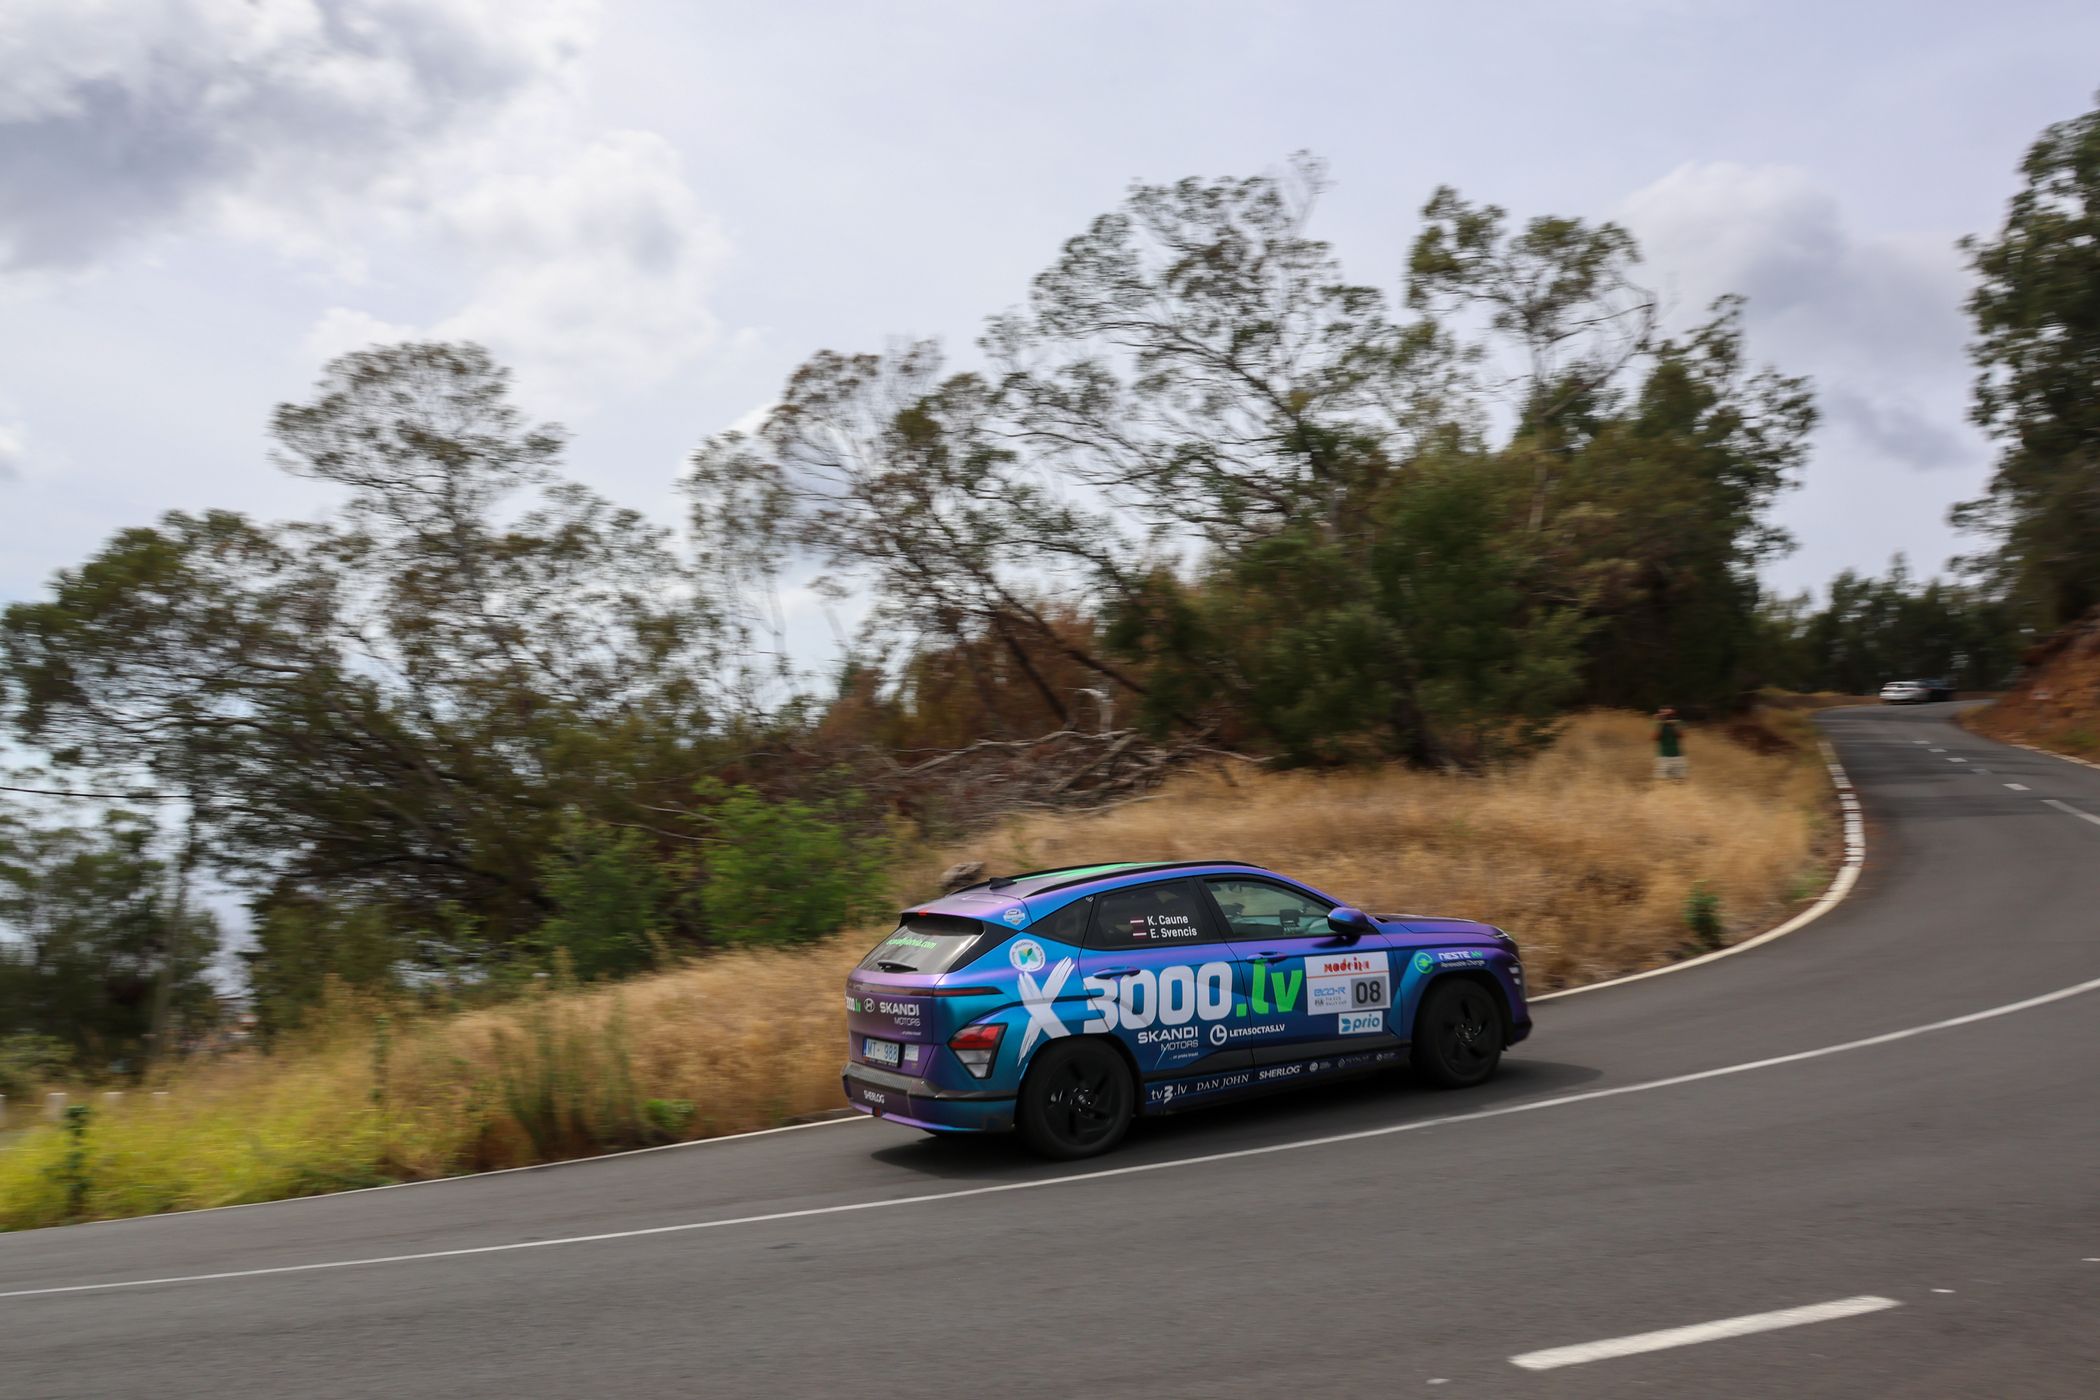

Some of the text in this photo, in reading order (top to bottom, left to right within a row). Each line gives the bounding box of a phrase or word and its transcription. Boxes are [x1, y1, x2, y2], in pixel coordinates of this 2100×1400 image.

[1147, 914, 1189, 926] K. Caune
[1150, 926, 1198, 939] E. Svencis
[1355, 980, 1381, 1004] 08
[879, 1001, 920, 1017] SKANDI
[1229, 1024, 1285, 1037] LETASOCTAS.LV
[1353, 1013, 1380, 1032] prio
[1137, 1026, 1199, 1044] SKANDI
[1160, 1039, 1199, 1052] MOTORS
[1258, 1065, 1301, 1080] SHERLOG
[1196, 1074, 1249, 1091] DAN JOHN
[1151, 1083, 1188, 1104] tv3.lv
